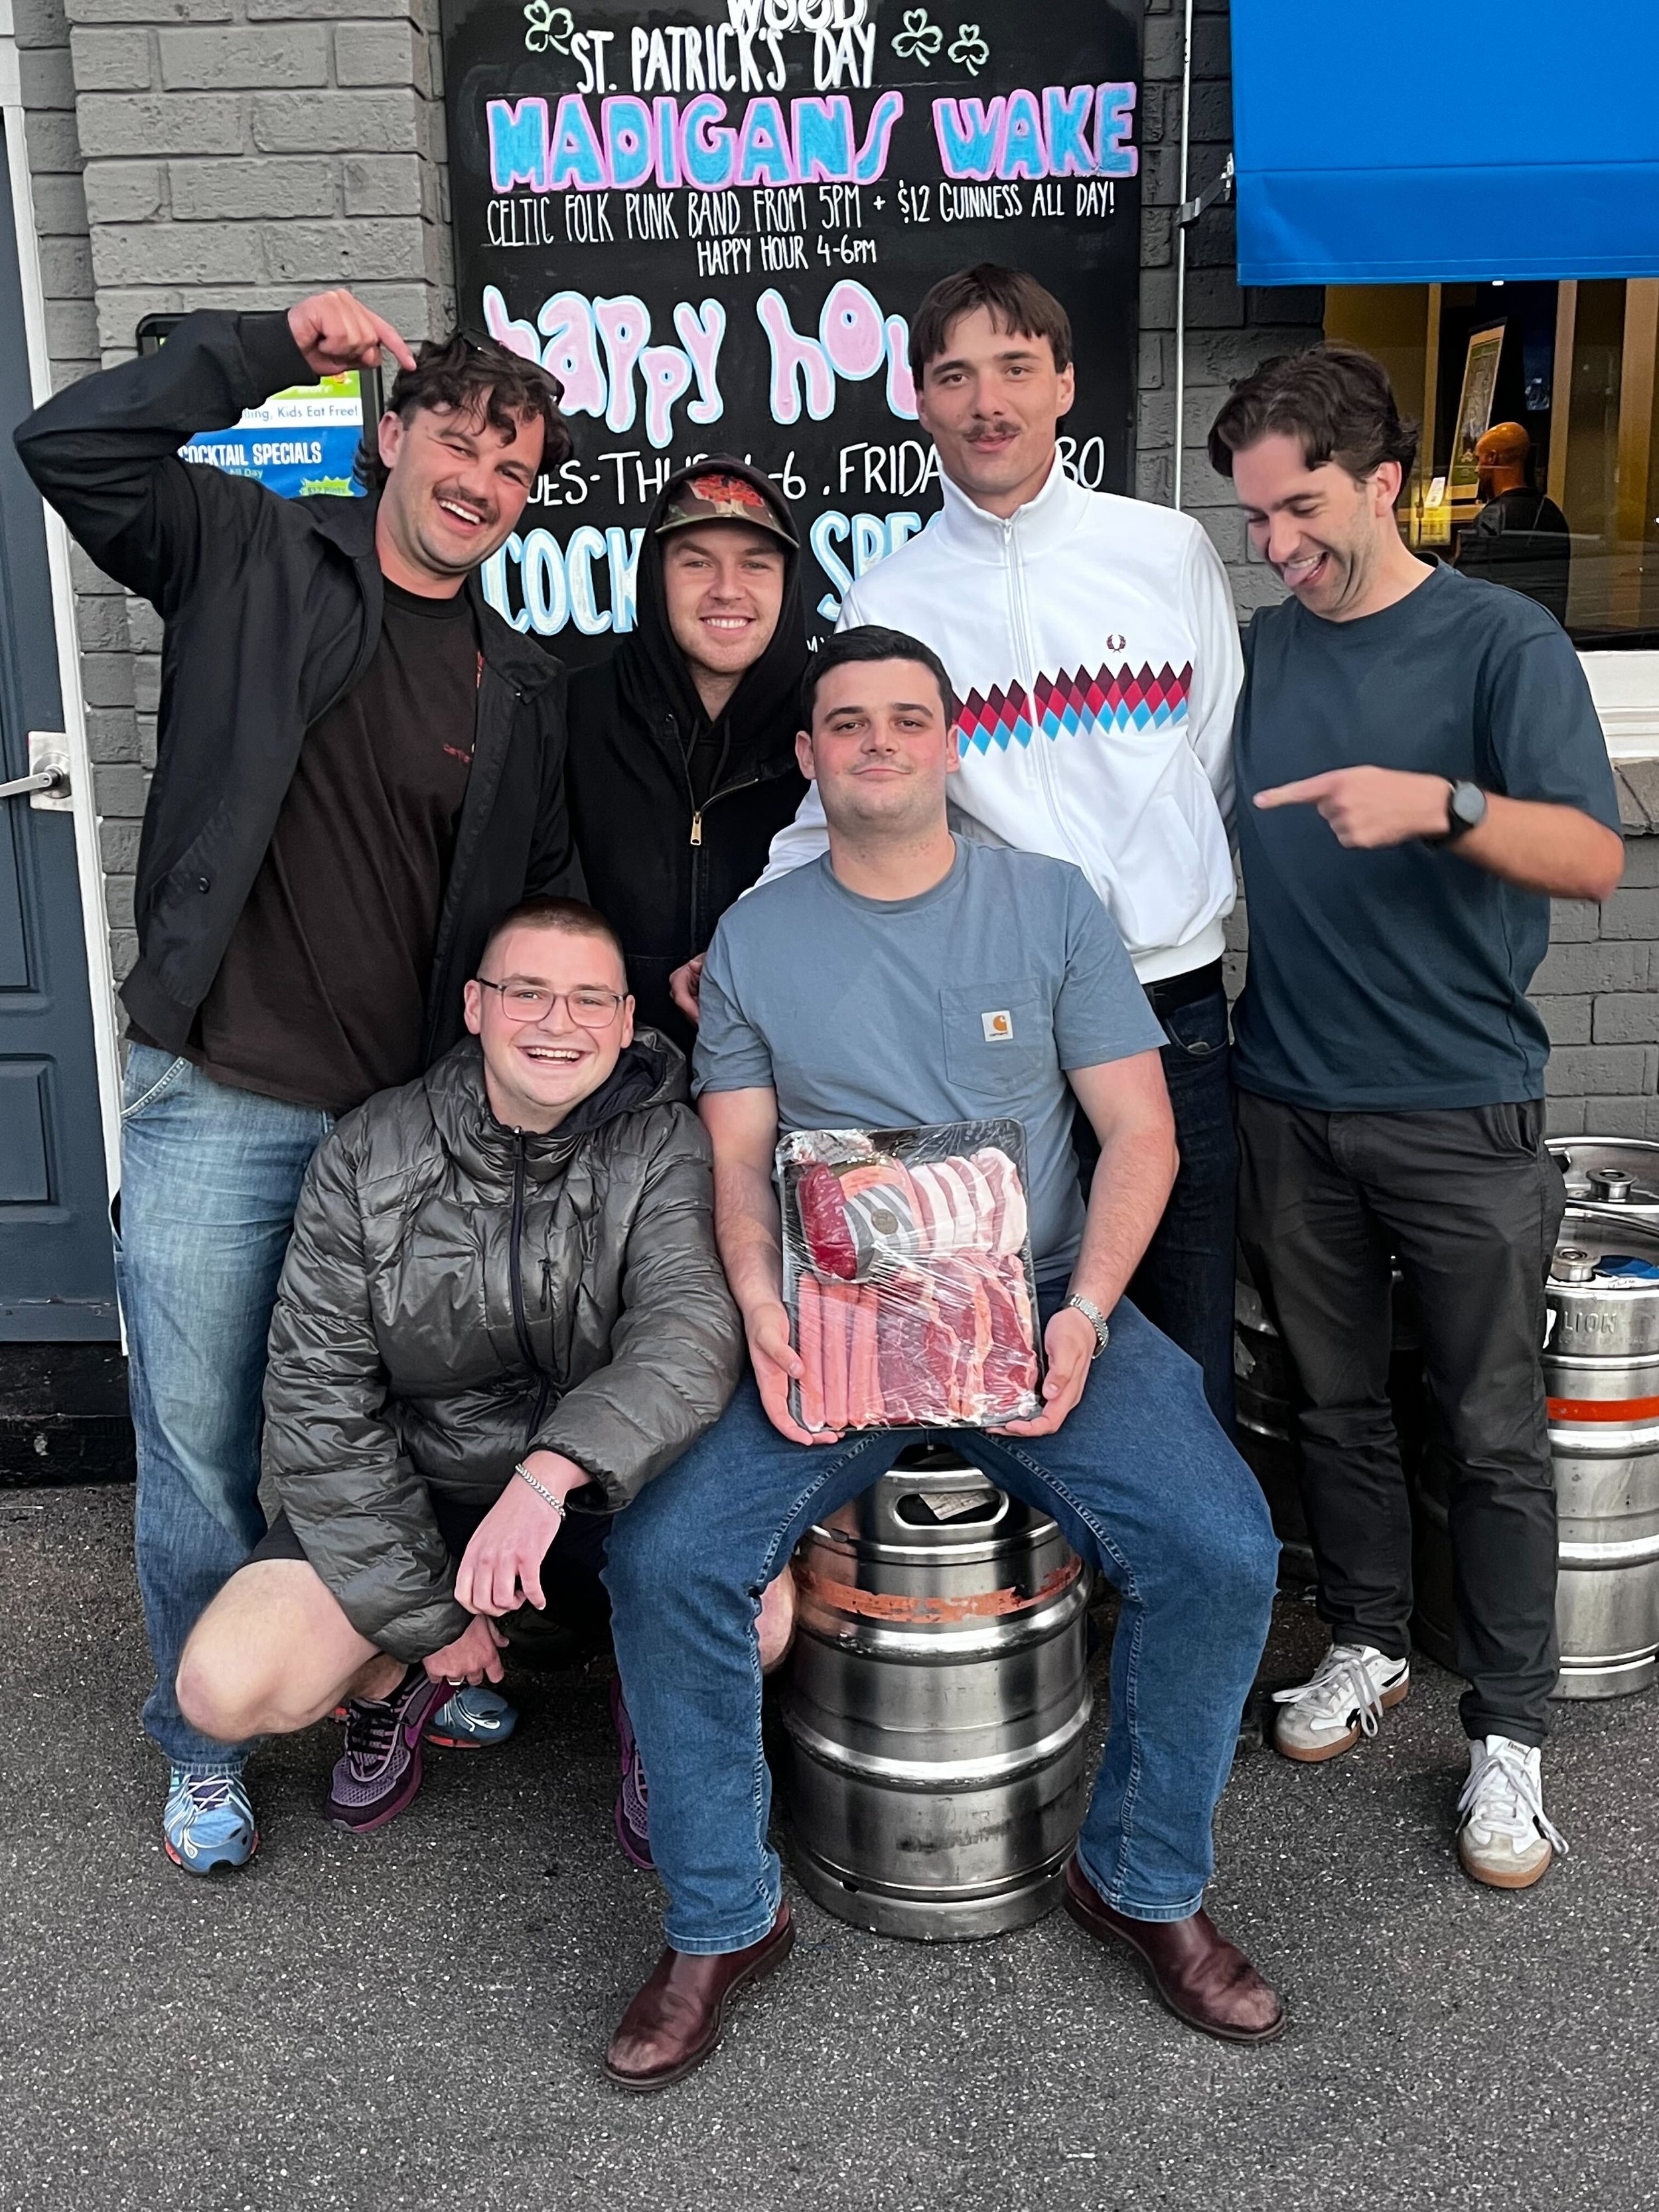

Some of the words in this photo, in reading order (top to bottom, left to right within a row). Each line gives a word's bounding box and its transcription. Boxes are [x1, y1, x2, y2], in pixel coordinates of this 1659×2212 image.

[571, 30, 617, 94] ST.
[631, 23, 786, 93] PATRICK'S
[814, 22, 876, 92] DAY
[486, 92, 904, 193] MADIGANS
[932, 82, 1138, 181] WAKE
[487, 197, 554, 246] CELTIC
[565, 193, 614, 242] FOLK
[625, 191, 680, 240] PUNK
[687, 189, 741, 239] BAND
[753, 186, 808, 233] FROM
[819, 184, 862, 230] 5PM
[898, 180, 930, 224] $12
[939, 182, 1023, 222] GUINNESS
[1031, 183, 1064, 218] ALL
[1076, 181, 1116, 218] DAY!
[697, 238, 751, 277] HAPPY
[760, 235, 809, 271] HOUR
[817, 235, 877, 267] 4-6PM
[757, 279, 920, 425] hou
[277, 405, 303, 418] Kids
[307, 406, 326, 417] Eat
[329, 404, 359, 417] Free!
[177, 444, 250, 467] COCKTAIL
[252, 441, 323, 465] SPECIALS
[244, 468, 263, 479] Day
[839, 441, 943, 497] FRIDA
[481, 526, 646, 636] COCK
[1563, 1310, 1617, 1334] LION
